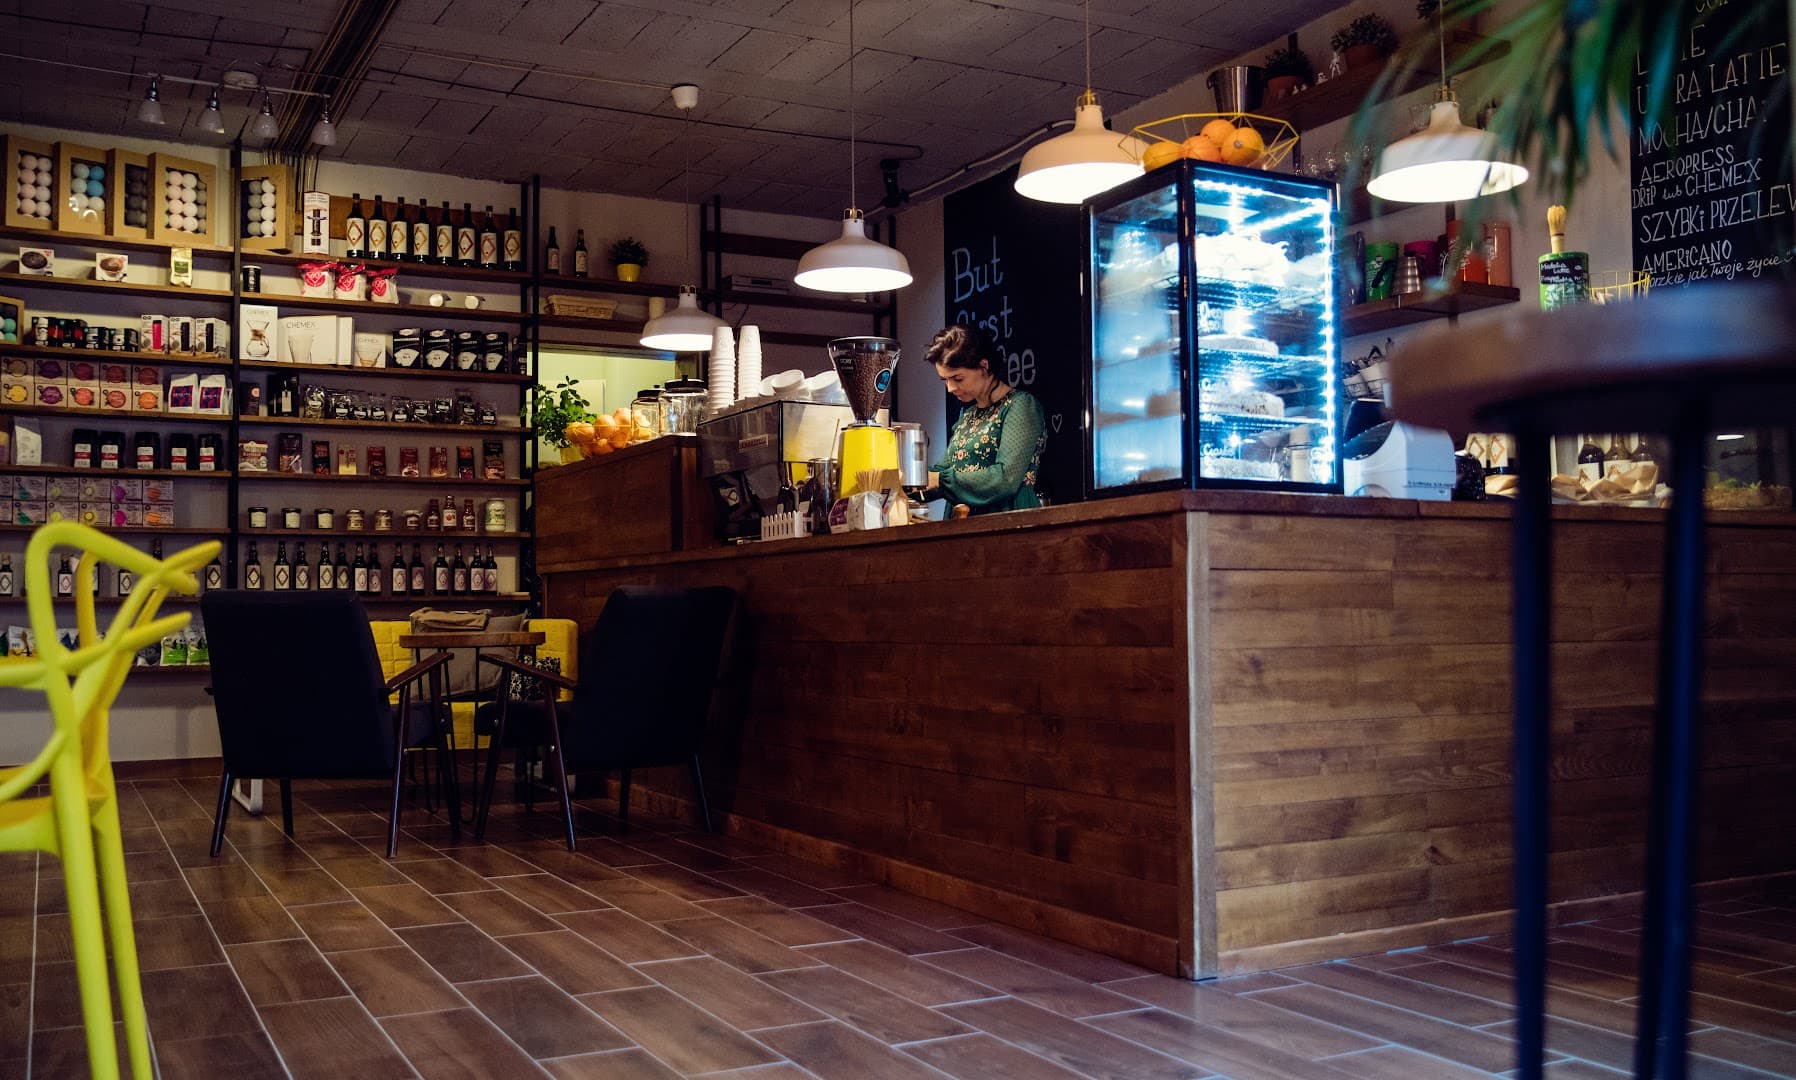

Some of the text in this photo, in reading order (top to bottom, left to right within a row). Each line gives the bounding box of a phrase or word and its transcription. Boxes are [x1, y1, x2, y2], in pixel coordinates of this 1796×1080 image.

[1639, 144, 1735, 187] AEROPRESS
[1684, 157, 1763, 198] CHEMEX
[952, 235, 1004, 304] But
[1684, 265, 1709, 288] jak
[1709, 257, 1744, 281] Twoje
[286, 321, 316, 329] CHEMEX
